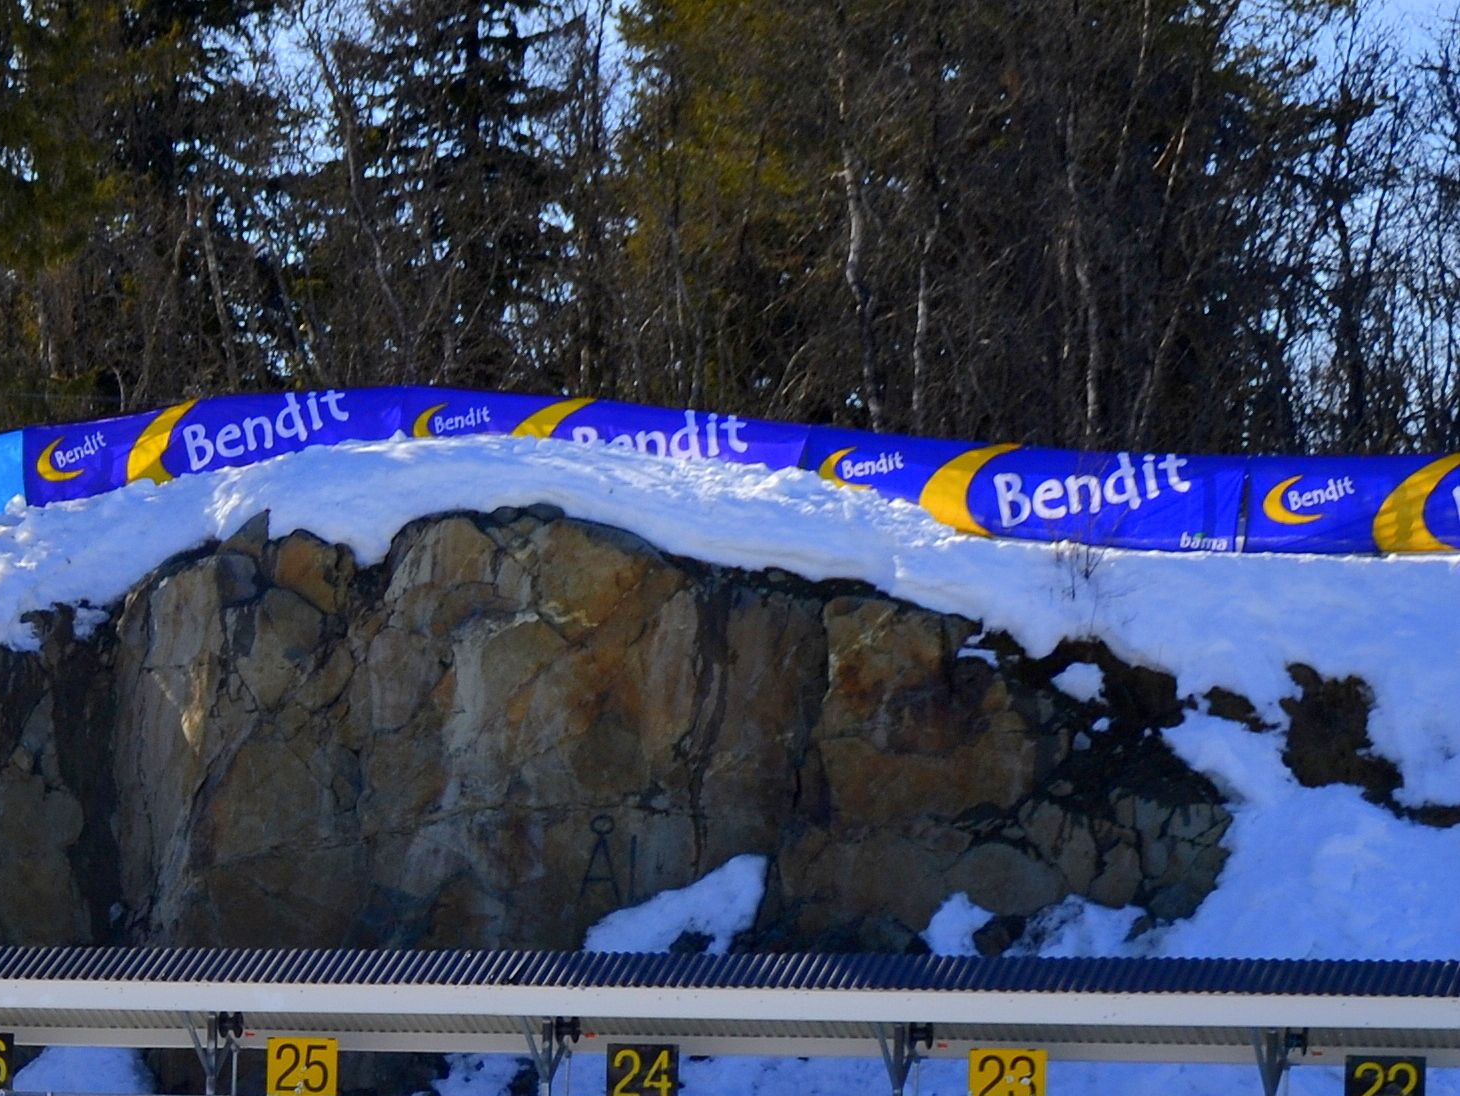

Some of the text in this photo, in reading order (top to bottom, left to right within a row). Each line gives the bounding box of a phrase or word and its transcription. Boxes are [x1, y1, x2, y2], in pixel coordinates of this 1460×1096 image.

[183, 387, 350, 472] Bendit
[433, 405, 491, 435] Bendit
[55, 431, 106, 468] Bendit
[841, 450, 904, 478] Bendit
[992, 452, 1191, 528] Bendit
[1288, 476, 1355, 511] Bendit
[275, 1043, 328, 1093] 25
